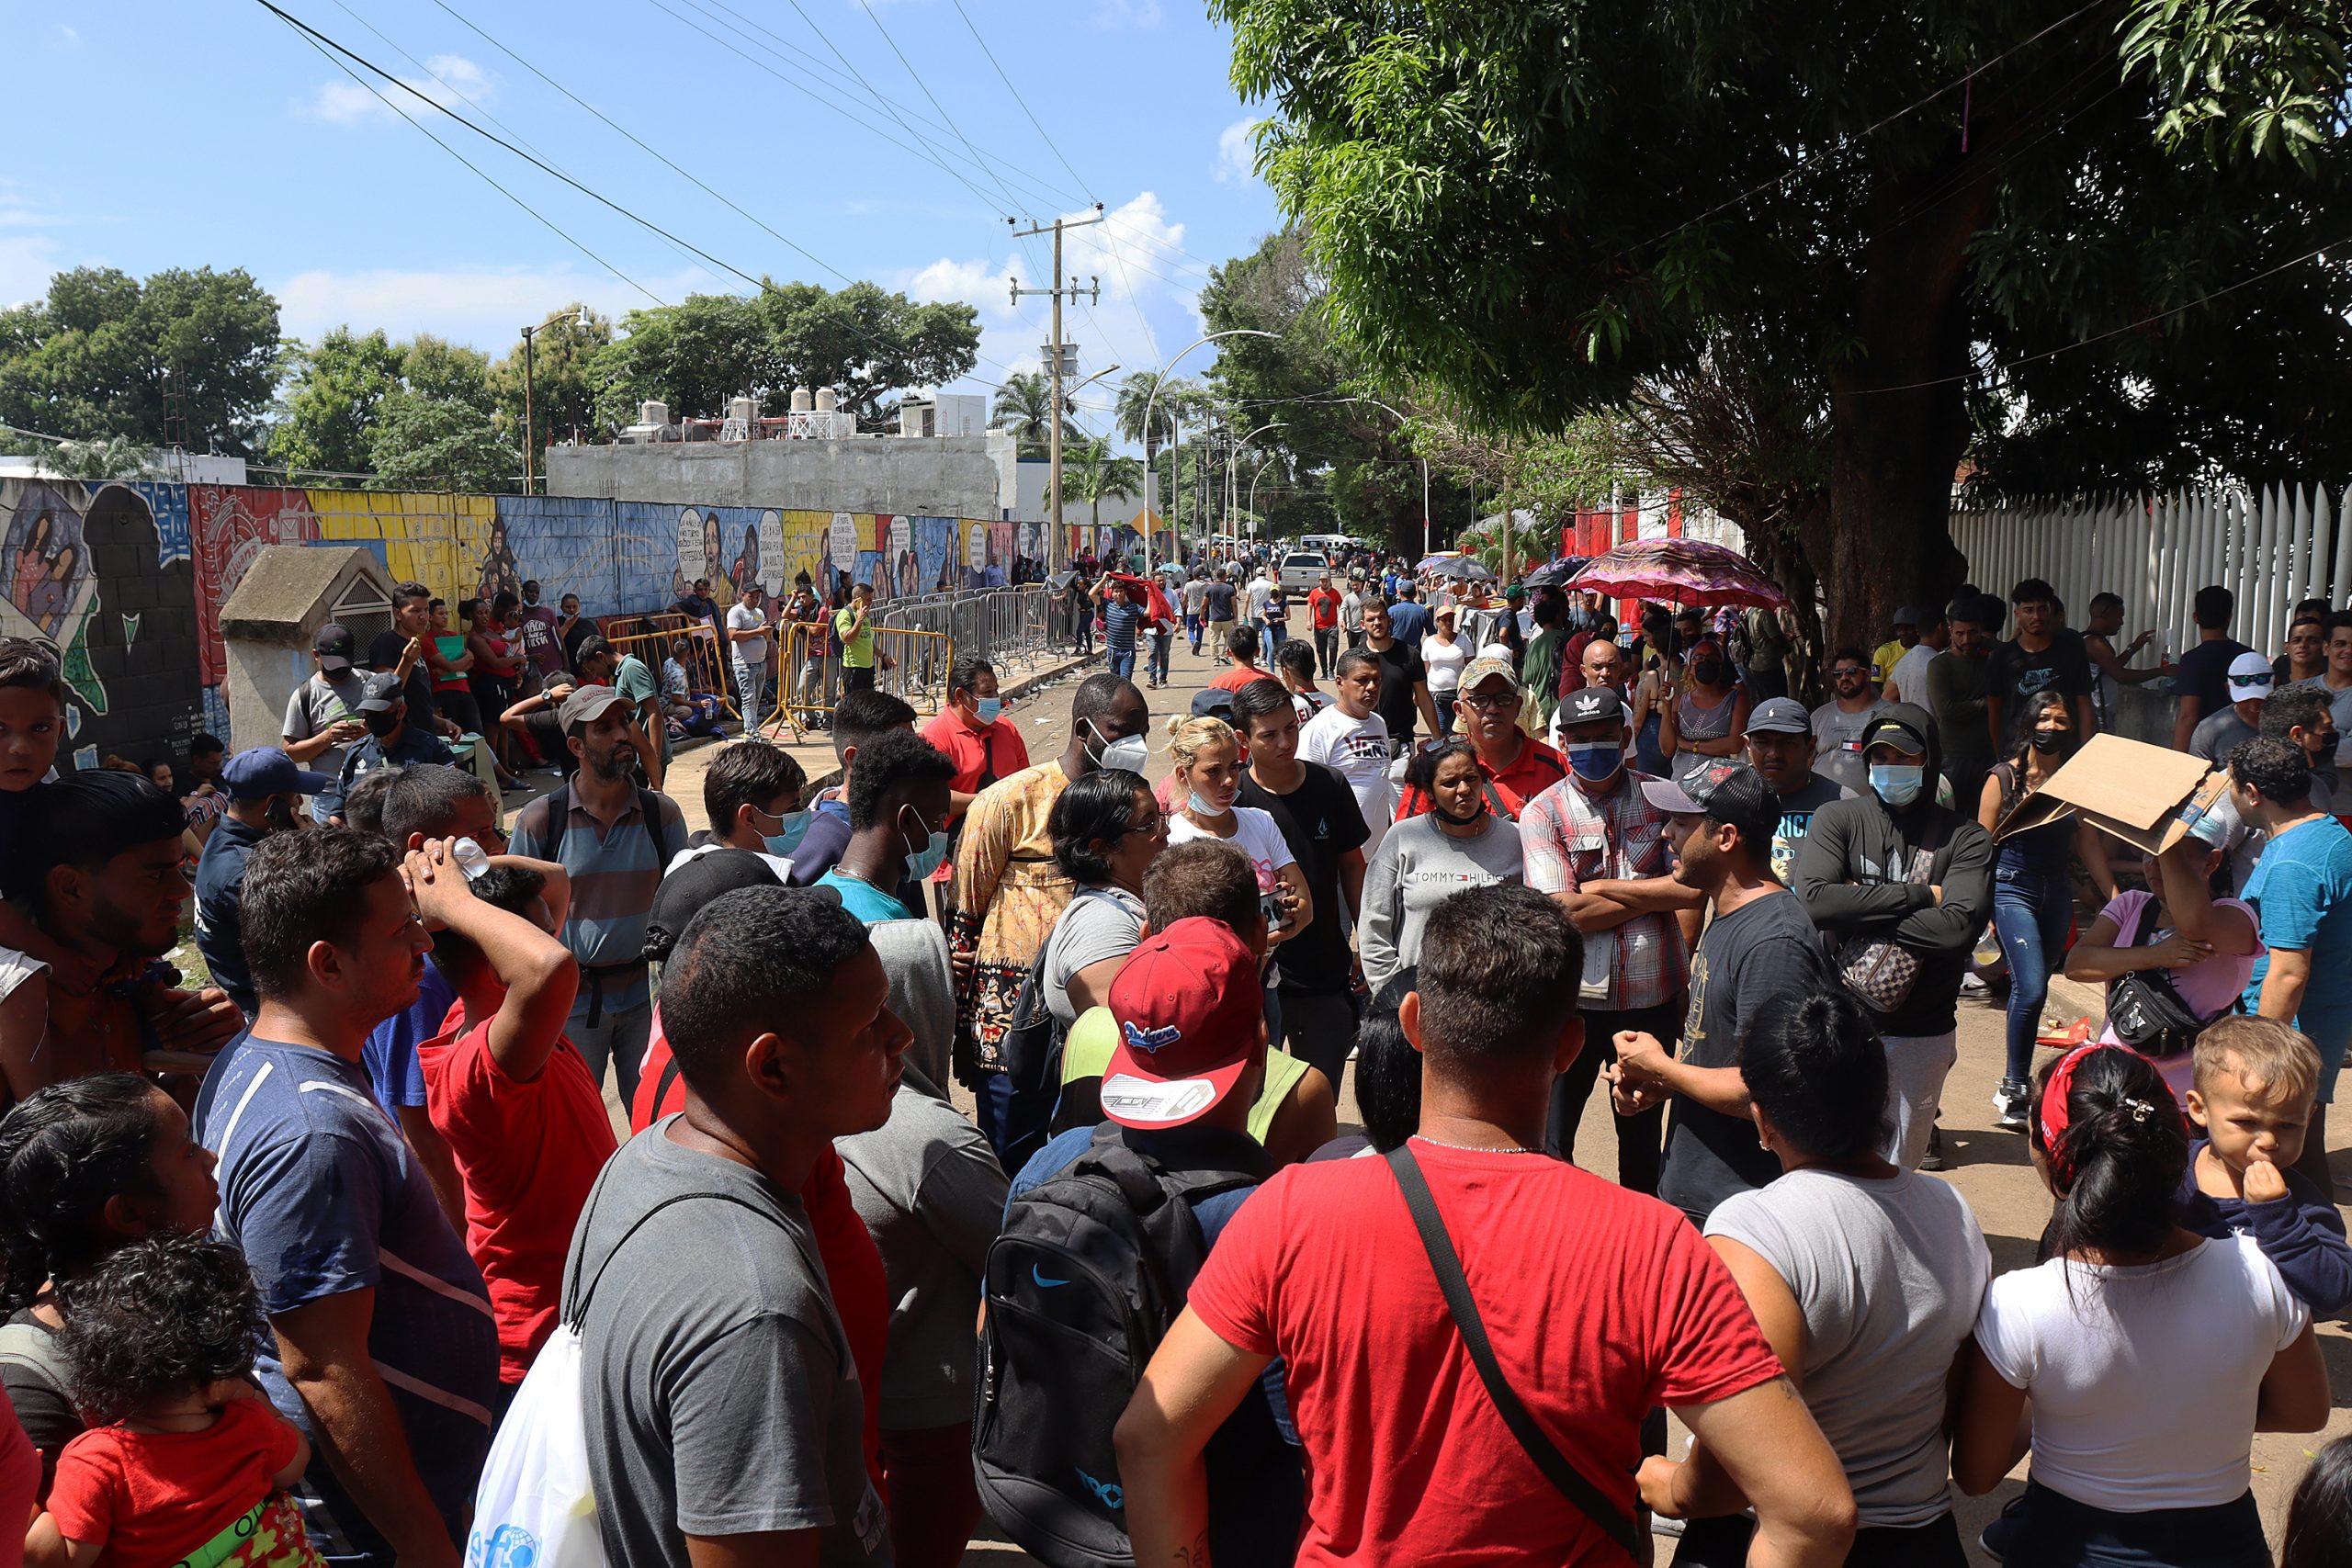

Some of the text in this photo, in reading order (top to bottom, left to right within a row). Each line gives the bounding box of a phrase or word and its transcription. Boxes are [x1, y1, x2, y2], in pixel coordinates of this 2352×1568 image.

[1577, 709, 1600, 717] adidas
[1414, 873, 1455, 883] TOMMY
[1124, 1021, 1181, 1054] Dodgers
